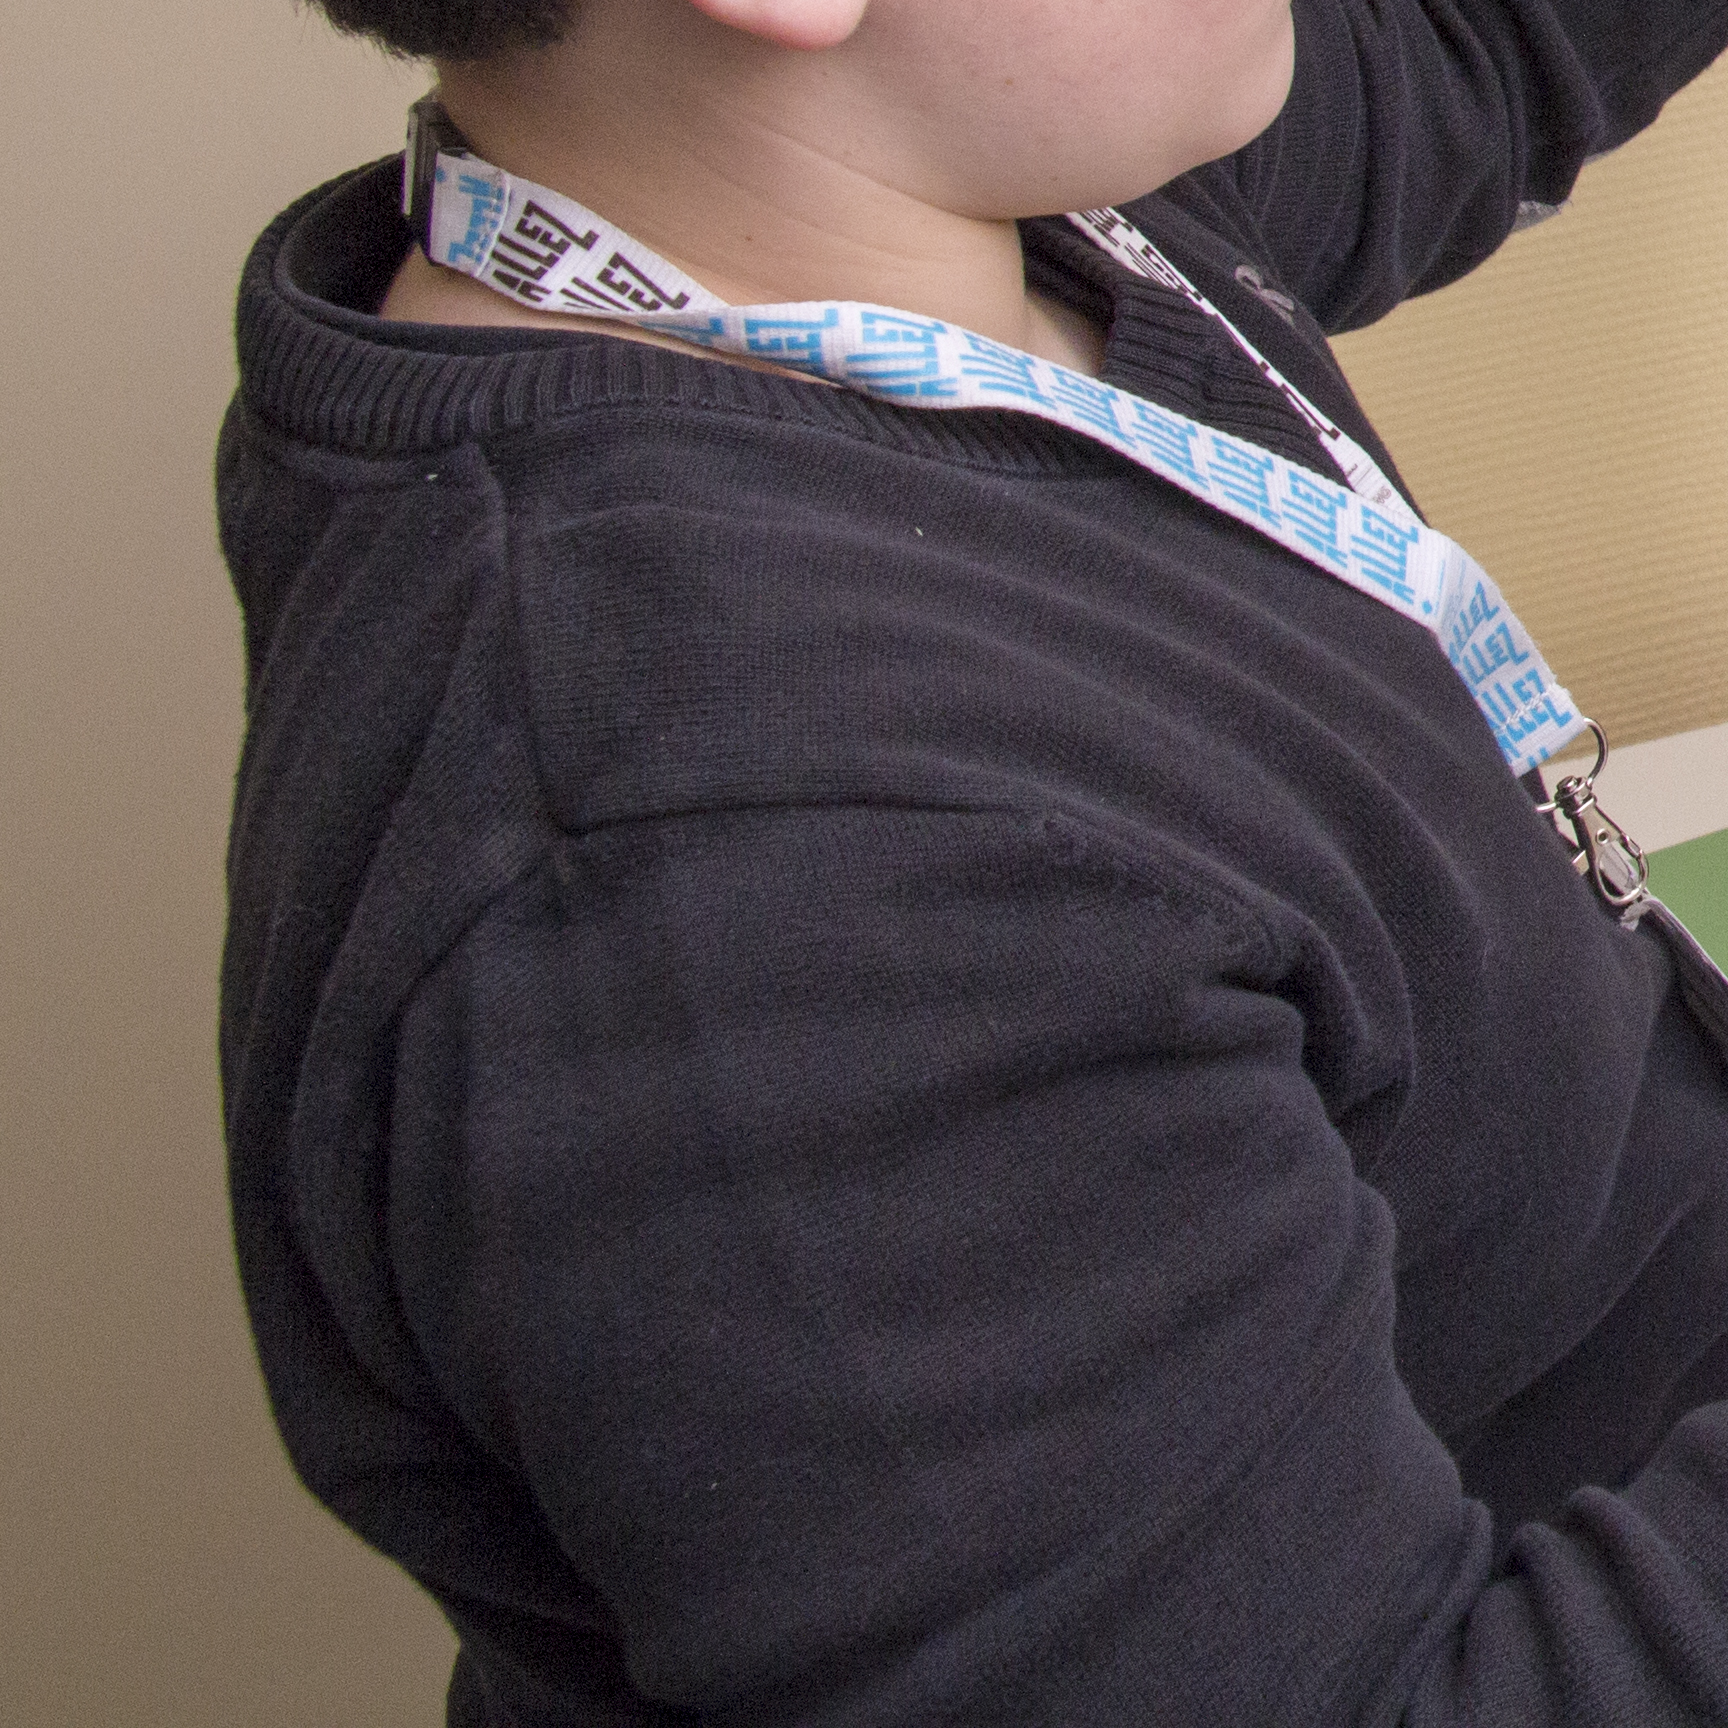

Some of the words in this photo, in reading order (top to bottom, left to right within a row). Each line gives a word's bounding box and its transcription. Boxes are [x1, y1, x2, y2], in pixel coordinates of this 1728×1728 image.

[491, 198, 600, 303] ALLEZ
[846, 310, 958, 396] ALLEZ
[1130, 398, 1212, 492] ALLEZ
[1206, 434, 1276, 530] ALLEZ
[1280, 468, 1348, 570] ALLEZ
[1350, 504, 1420, 606] ALLEZ
